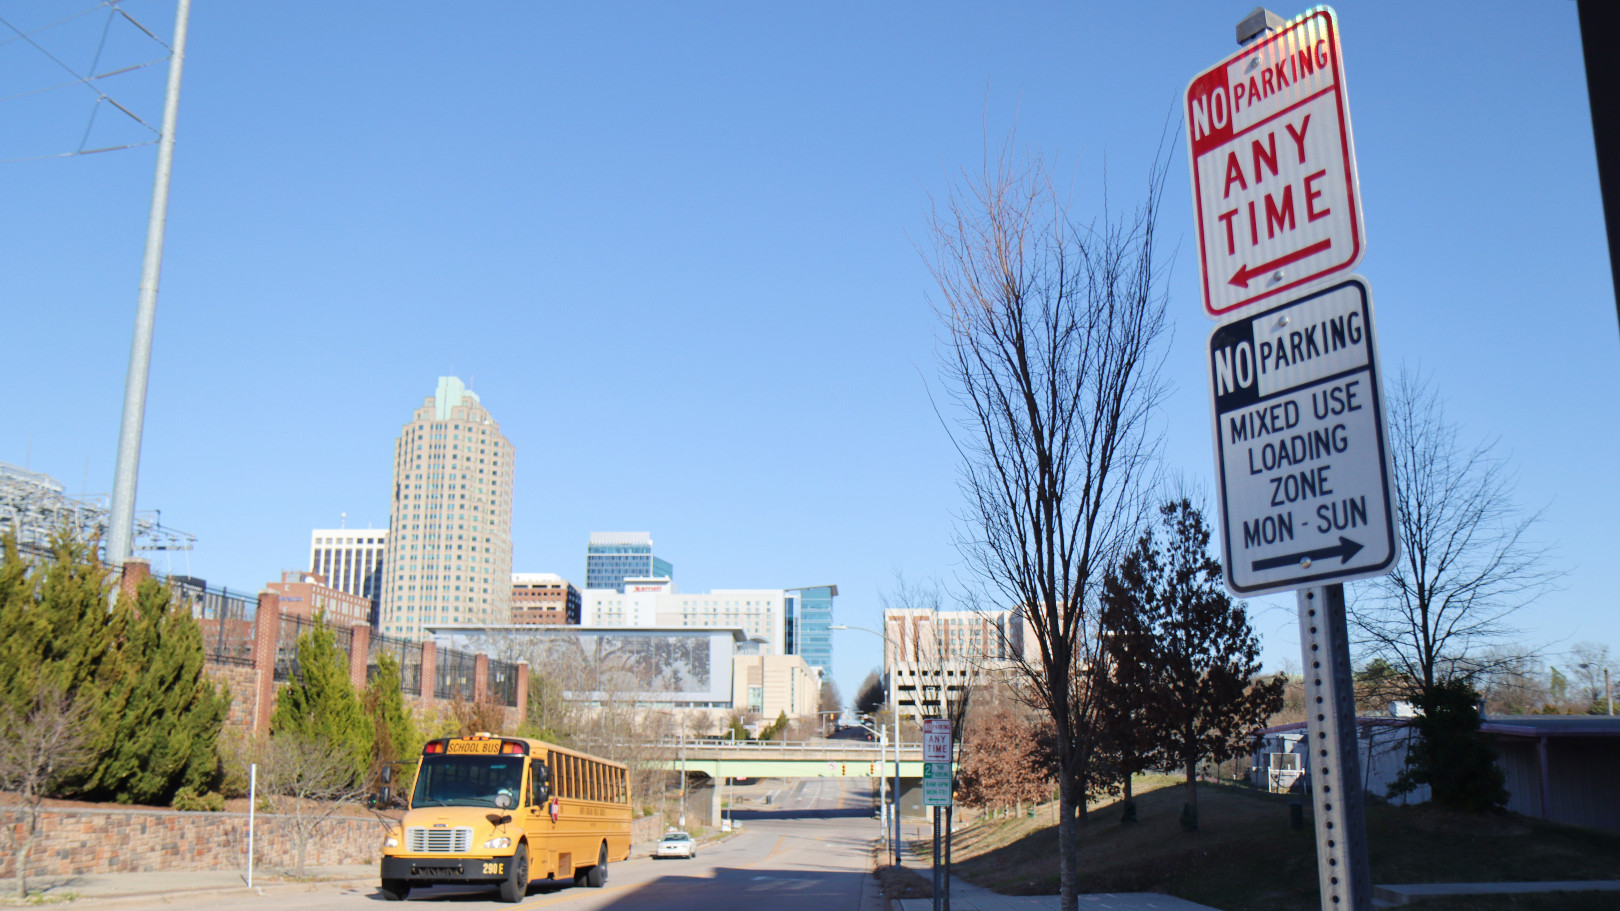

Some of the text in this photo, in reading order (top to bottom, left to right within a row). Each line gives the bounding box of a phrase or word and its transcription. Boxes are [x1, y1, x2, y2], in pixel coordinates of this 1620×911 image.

[1192, 39, 1329, 141] NO PARKING
[1223, 114, 1311, 199] ANY
[1218, 169, 1331, 256] TIME
[1214, 311, 1362, 397] NO PARKING
[1230, 381, 1362, 445] MIXED USE
[1248, 423, 1348, 476] LOADING
[1270, 465, 1333, 507] ZONE
[1243, 511, 1294, 550] MON
[1316, 495, 1368, 535] SUN
[448, 743, 499, 753] SCHOOL BUS
[927, 744, 947, 753] TIME
[928, 735, 946, 743] ANY
[925, 765, 931, 776] 2
